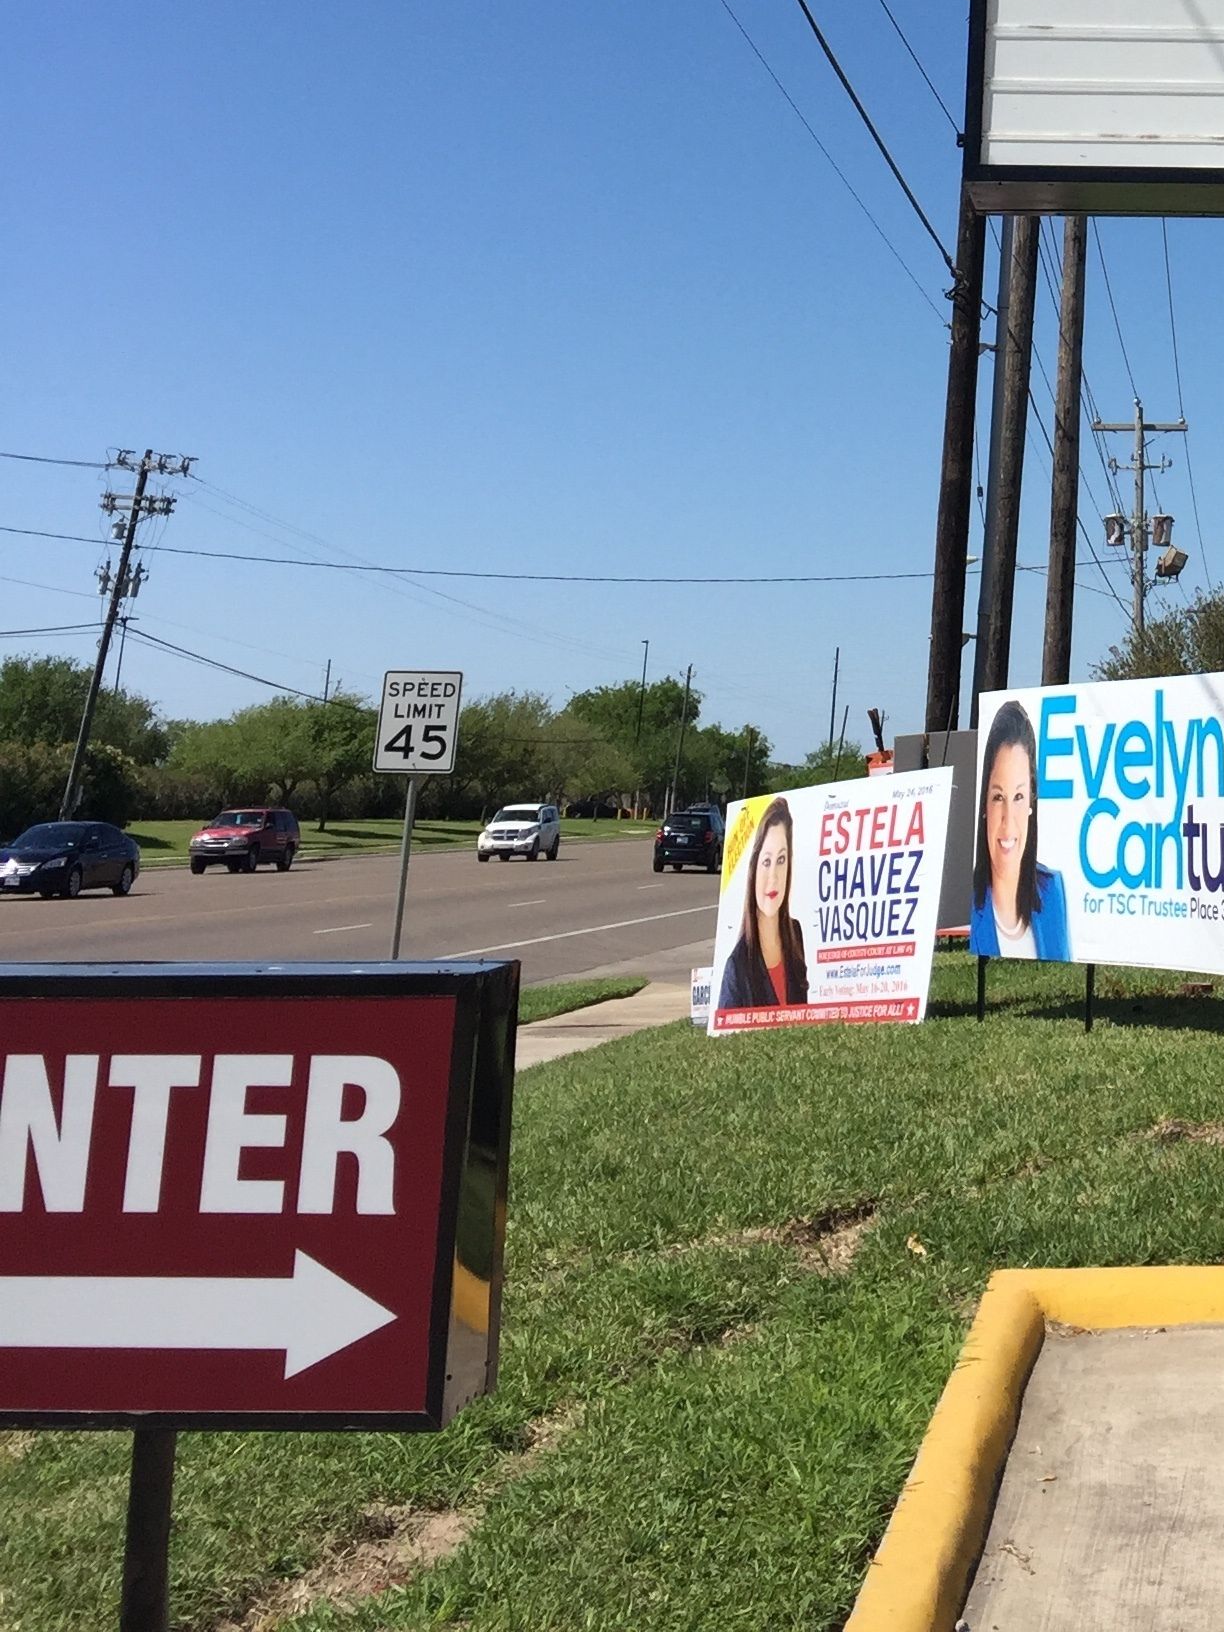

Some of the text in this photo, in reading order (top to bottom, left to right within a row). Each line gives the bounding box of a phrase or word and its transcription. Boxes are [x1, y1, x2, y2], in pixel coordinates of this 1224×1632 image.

[388, 681, 456, 698] SPEED
[394, 703, 446, 718] LIMIT
[384, 724, 447, 760] 45
[819, 801, 925, 856] ESTELA
[819, 850, 923, 902] CHAVEZ
[819, 898, 918, 942] VASQUEZ
[1083, 893, 1104, 914] for
[1107, 893, 1136, 915] TSC
[1139, 895, 1187, 918] Trustee
[1190, 897, 1218, 920] Place
[0, 1054, 401, 1215] NTER
